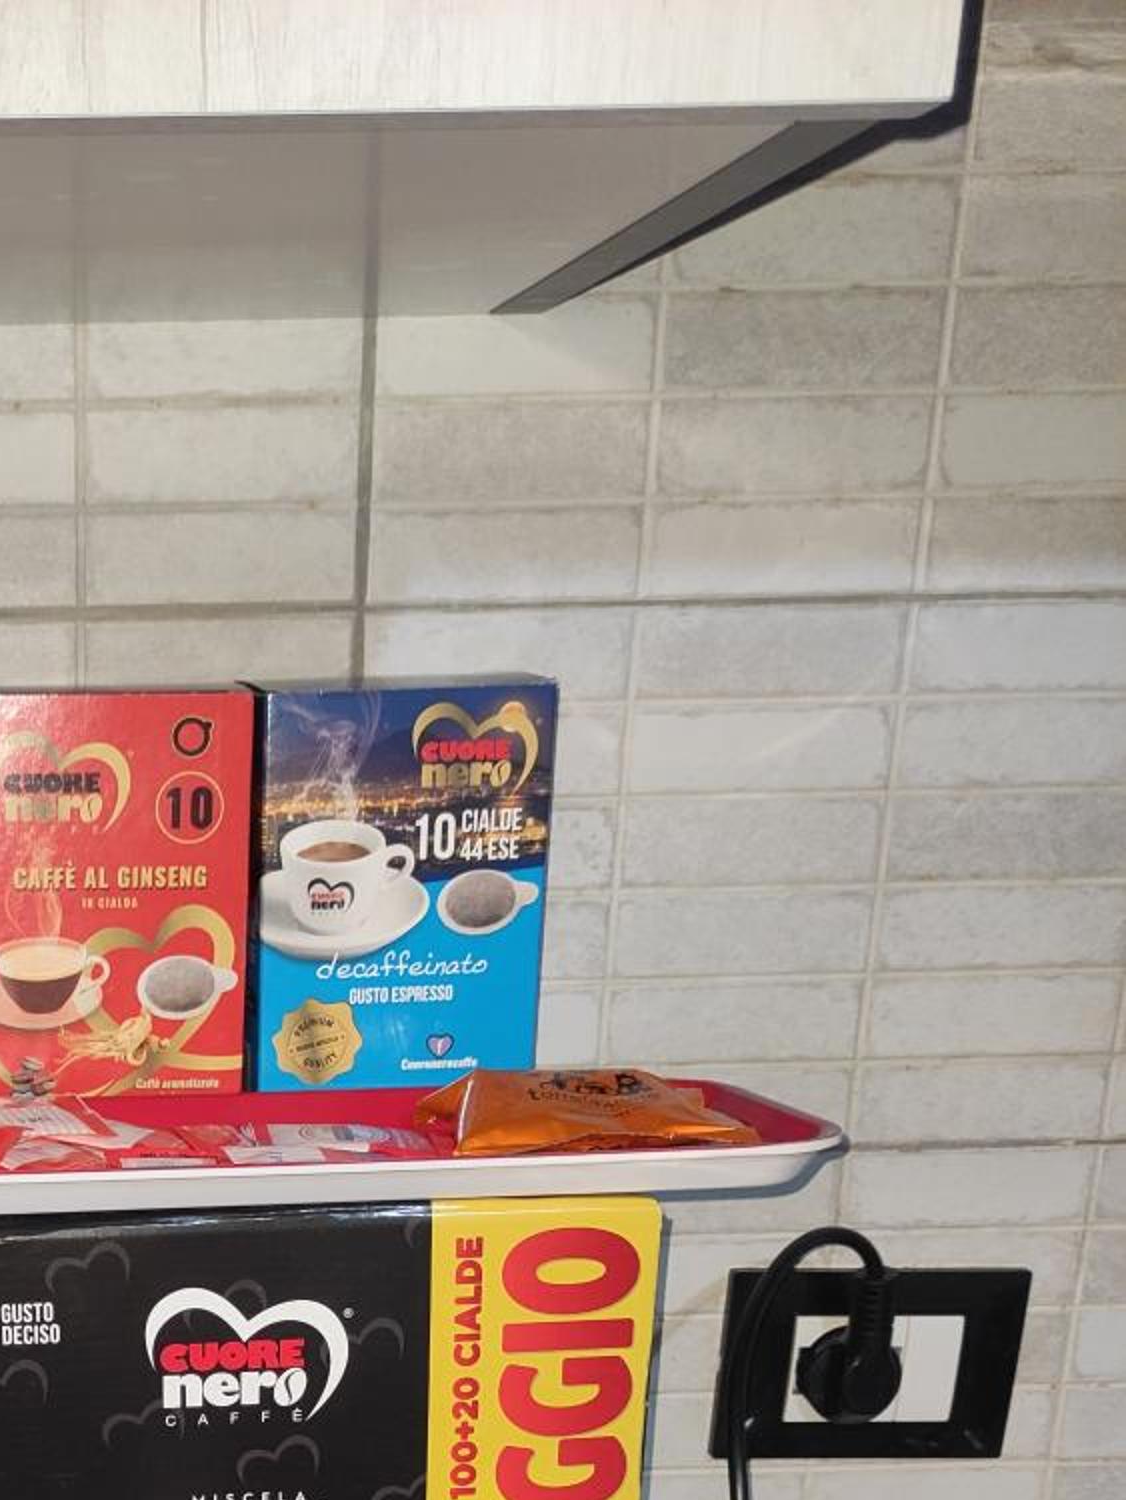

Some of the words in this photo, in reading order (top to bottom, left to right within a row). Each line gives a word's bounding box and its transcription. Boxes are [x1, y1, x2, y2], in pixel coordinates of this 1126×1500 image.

[420, 739, 513, 761] CUORE
[3, 772, 101, 794] CUORE
[421, 760, 513, 788] nero
[166, 787, 214, 830] 10
[461, 807, 523, 833] CIALDE
[415, 812, 456, 861] 10
[460, 837, 485, 862] 44
[487, 834, 520, 860] ESE
[13, 860, 77, 890] CAFFÈ
[83, 867, 109, 888] AL
[117, 865, 208, 889] GINSENG
[315, 951, 488, 981] decaffeinato
[349, 986, 389, 1005] GUSTO
[391, 984, 453, 1004] ESPRESSO
[0, 1301, 54, 1324] GUSTO
[453, 1236, 484, 1367] CIALDE
[1, 1323, 61, 1345] DECISO
[160, 1337, 305, 1372] CUORE
[162, 1367, 307, 1409] nero
[449, 1377, 480, 1500] 100+20
